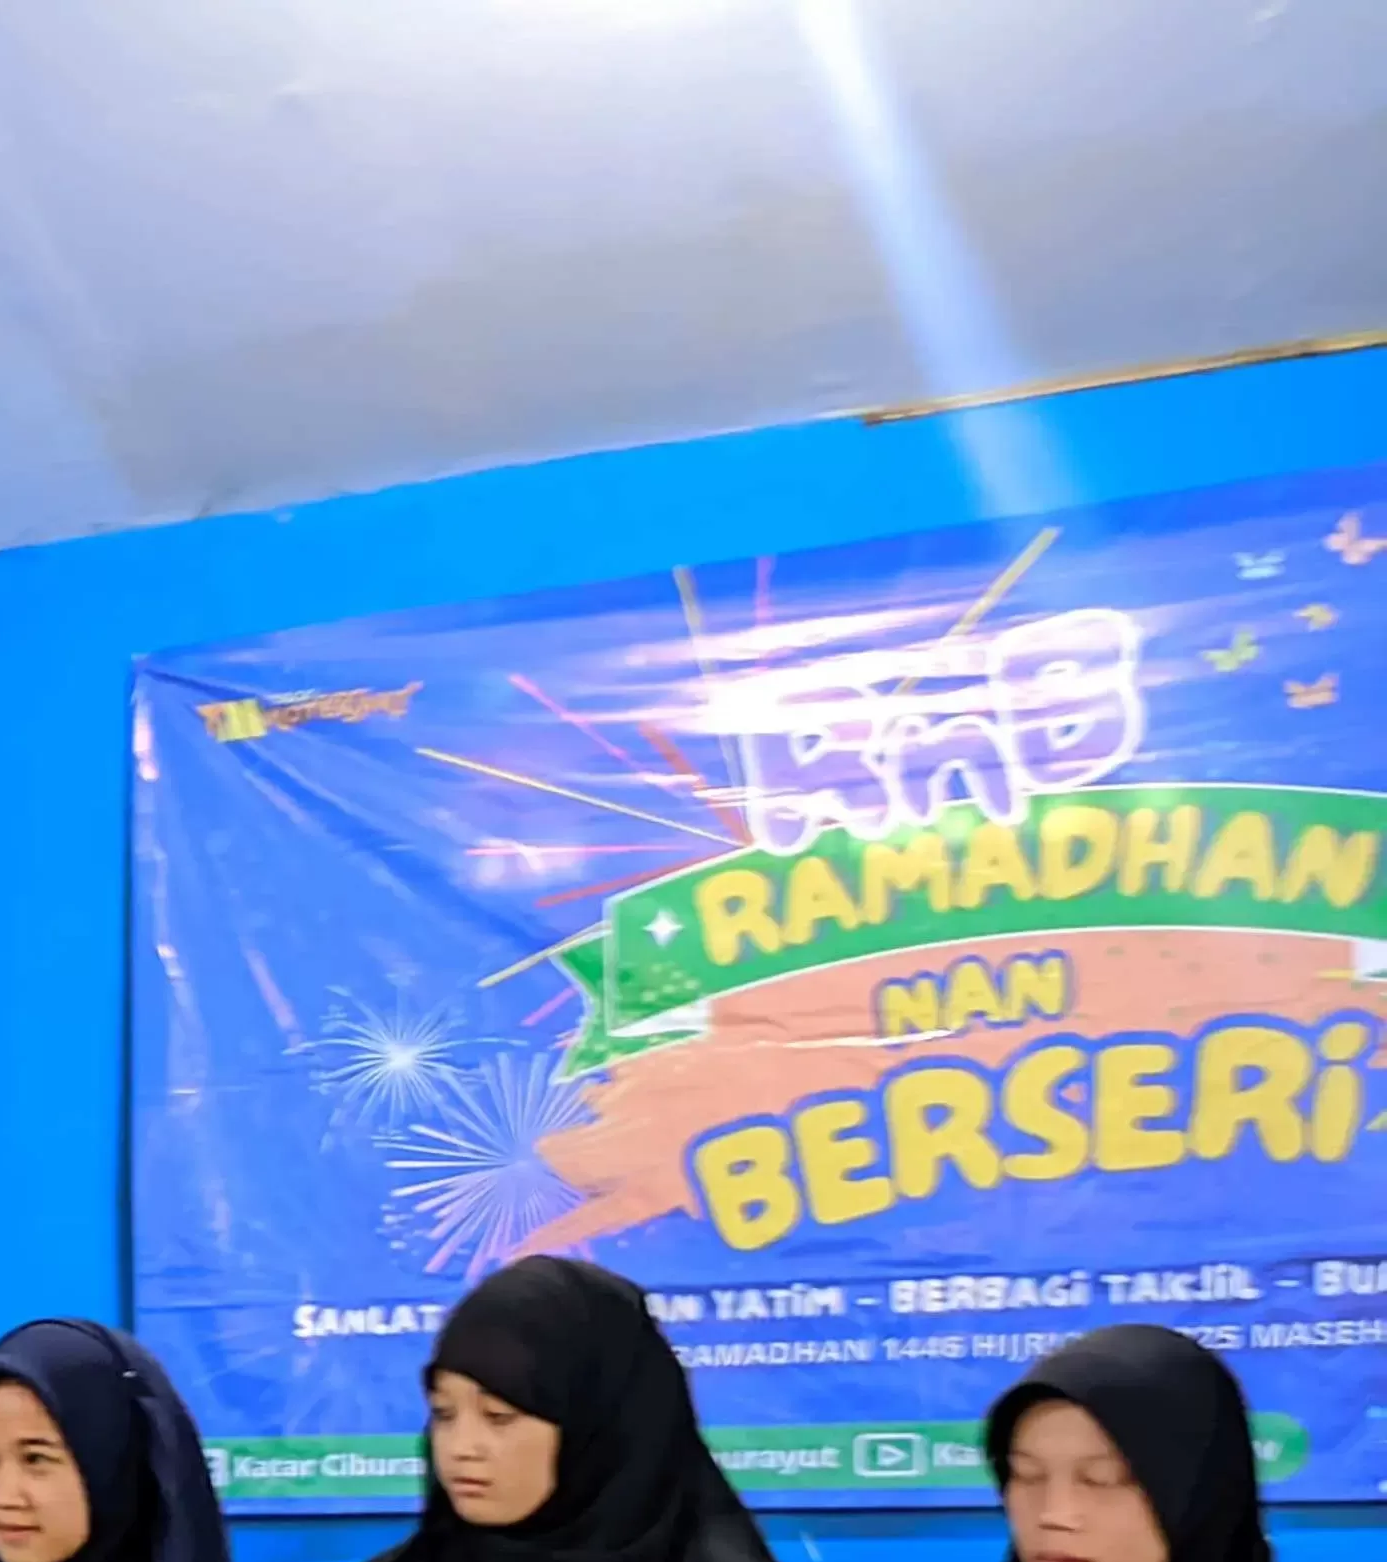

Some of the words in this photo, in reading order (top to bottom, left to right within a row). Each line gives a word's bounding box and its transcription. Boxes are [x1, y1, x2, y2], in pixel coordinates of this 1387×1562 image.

[693, 805, 1379, 966] RAMADHAN
[877, 952, 1069, 1038] NAN
[320, 1452, 427, 1477] Cibura
